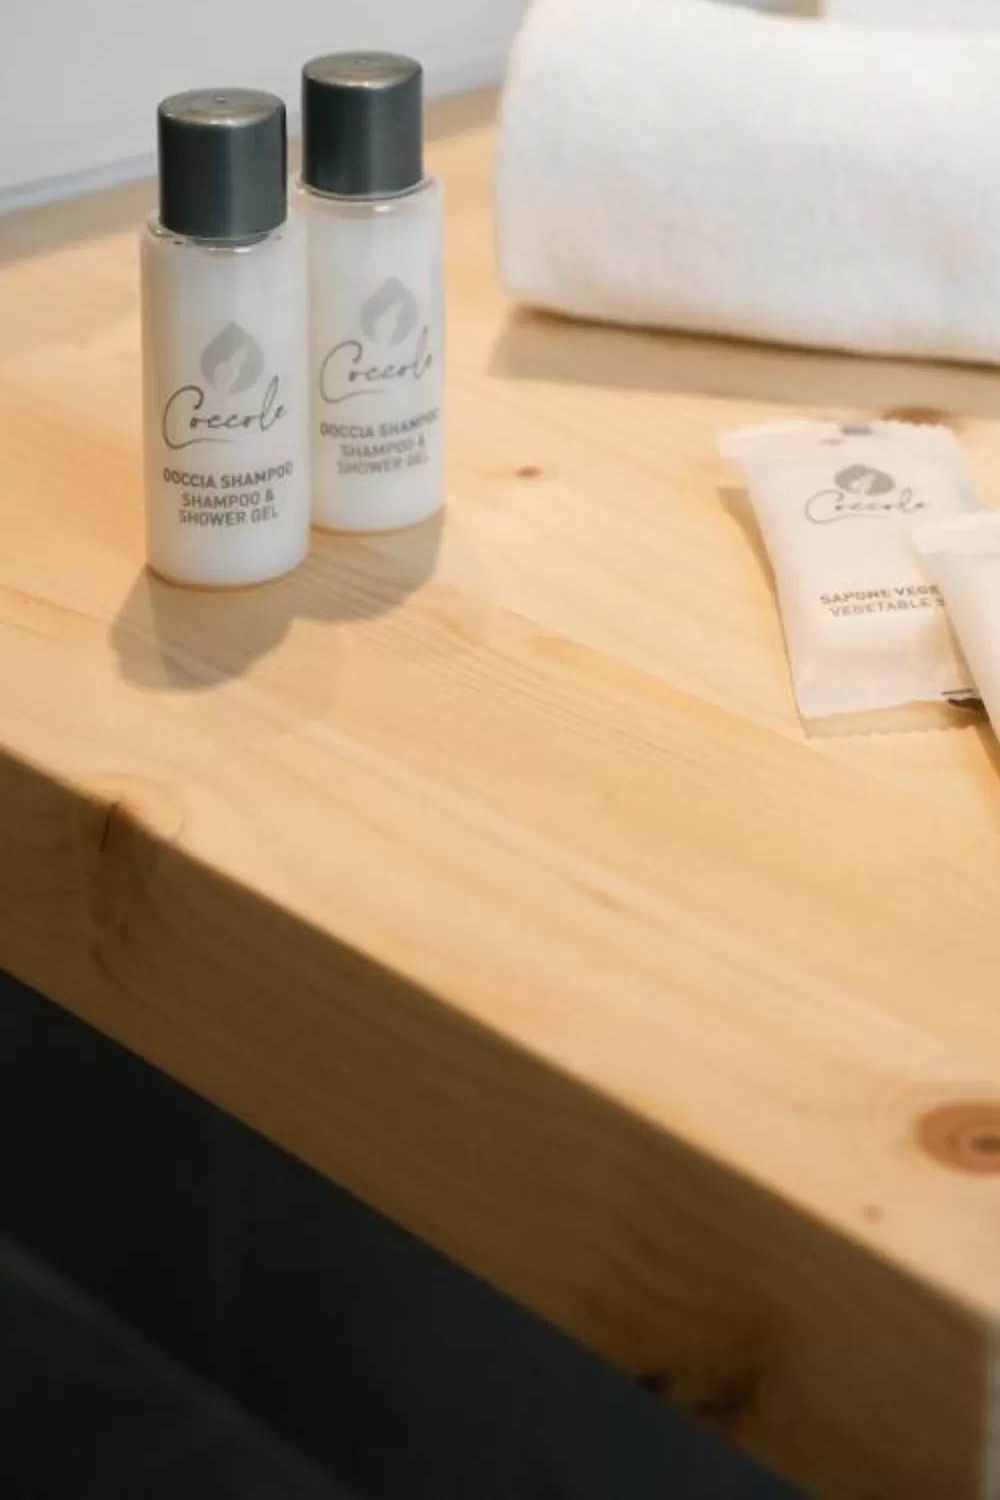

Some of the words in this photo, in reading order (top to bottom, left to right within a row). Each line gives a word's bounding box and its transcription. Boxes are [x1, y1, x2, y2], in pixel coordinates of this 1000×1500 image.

[162, 374, 287, 450] Coccole
[320, 420, 376, 438] DOCCIA
[163, 467, 217, 489] DOCCIA
[181, 489, 260, 509] SHAMPOO
[804, 487, 928, 526] Coccole
[178, 508, 246, 527] SHOWER
[251, 505, 279, 523] GEL
[819, 587, 891, 604] SAPONE
[894, 583, 941, 600] VEGE
[829, 598, 932, 617] VEGETABLE
